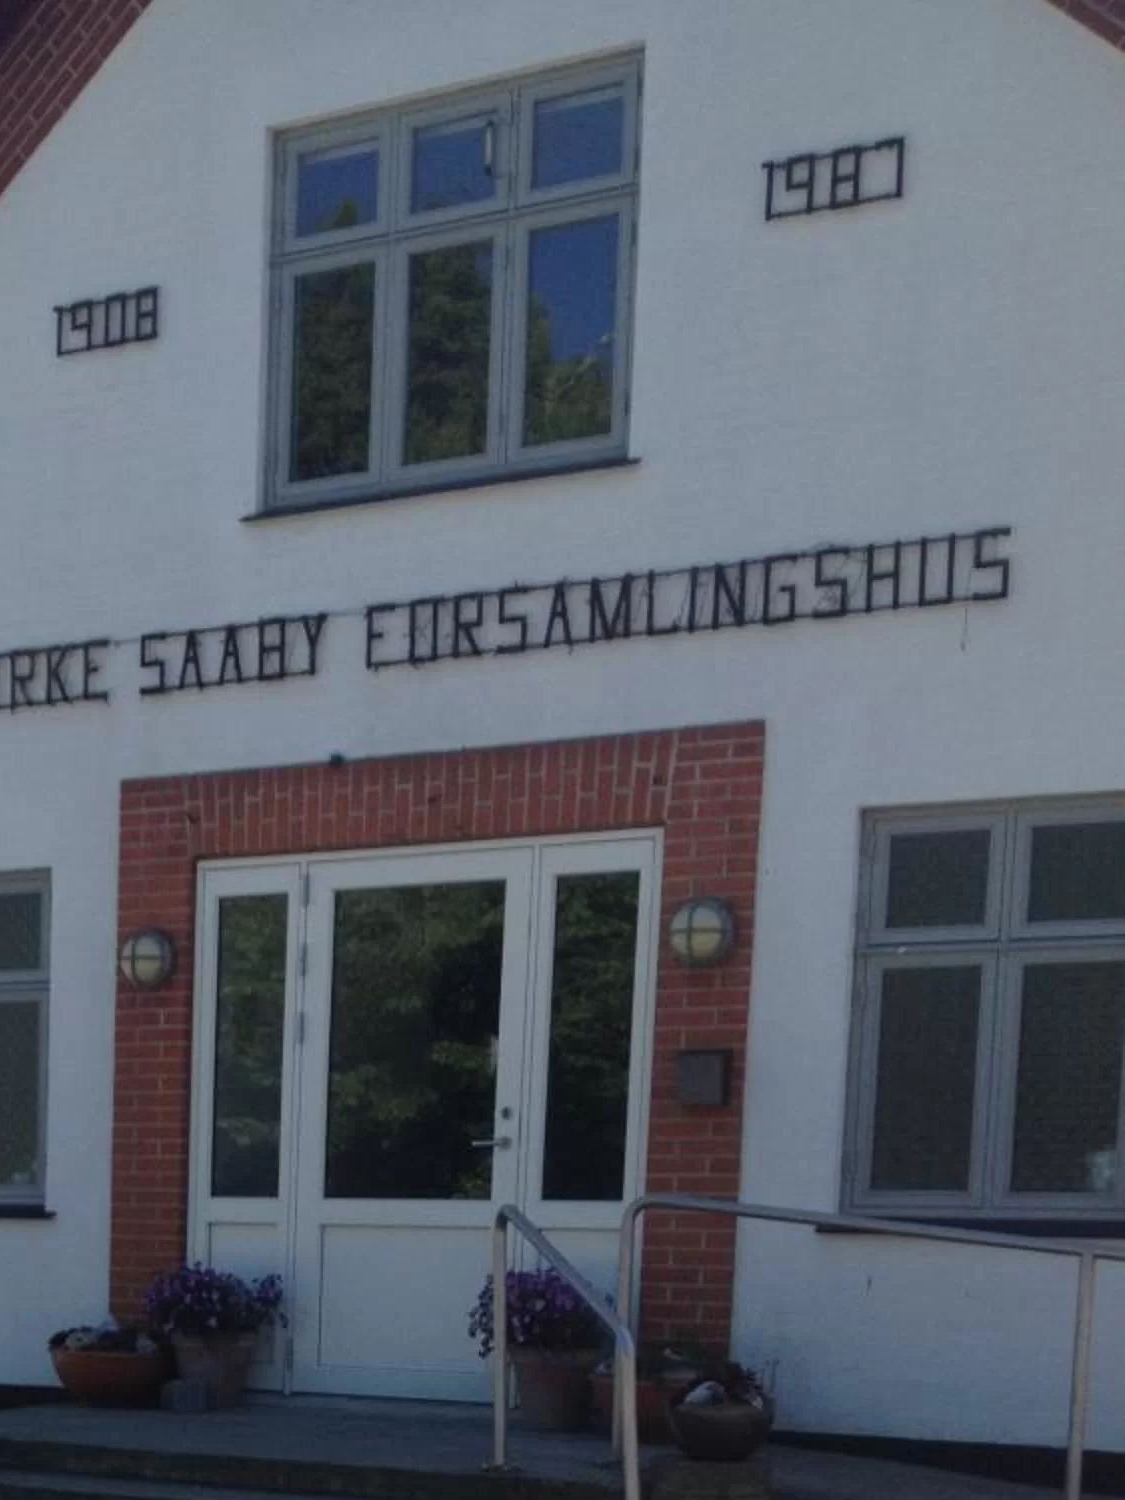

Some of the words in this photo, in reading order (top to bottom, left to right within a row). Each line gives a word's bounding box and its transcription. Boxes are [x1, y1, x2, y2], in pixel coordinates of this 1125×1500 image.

[762, 136, 904, 221] 1987
[53, 285, 159, 357] 1908
[139, 613, 328, 695] SAABY
[365, 527, 1011, 669] FORSAMLINGSHUS
